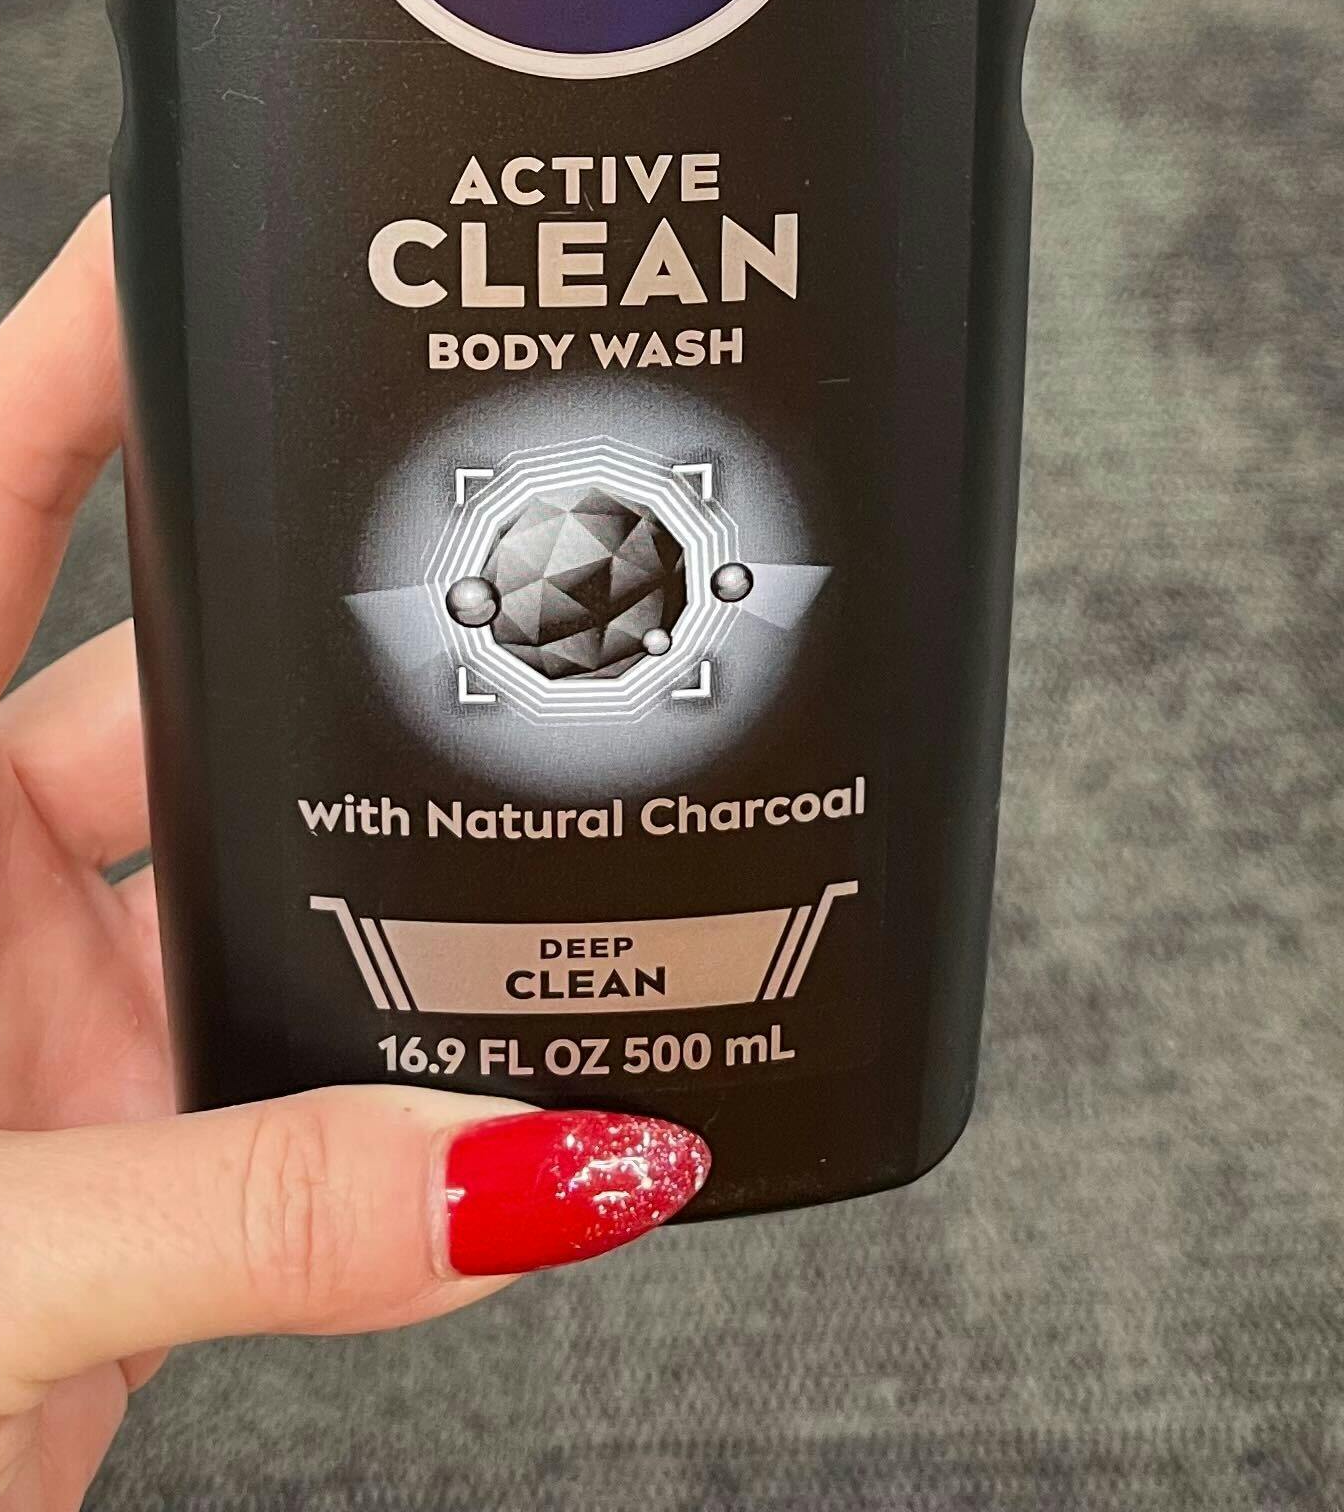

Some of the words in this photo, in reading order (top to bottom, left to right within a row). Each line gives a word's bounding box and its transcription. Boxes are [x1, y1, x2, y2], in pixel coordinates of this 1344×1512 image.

[449, 153, 720, 206] ACTIVE
[367, 212, 798, 308] CLEAN
[428, 333, 575, 371] BODY
[589, 327, 743, 370] WASH
[298, 793, 410, 837] with
[428, 798, 623, 840] Natural
[640, 775, 866, 835] Charcoal
[540, 937, 634, 960] DEEP
[505, 966, 666, 1000] CLEAN
[377, 1034, 466, 1075] 16.9
[479, 1039, 534, 1076] FL
[544, 1038, 610, 1076] OZ
[622, 1032, 712, 1074] 500
[725, 1024, 796, 1067] mL
